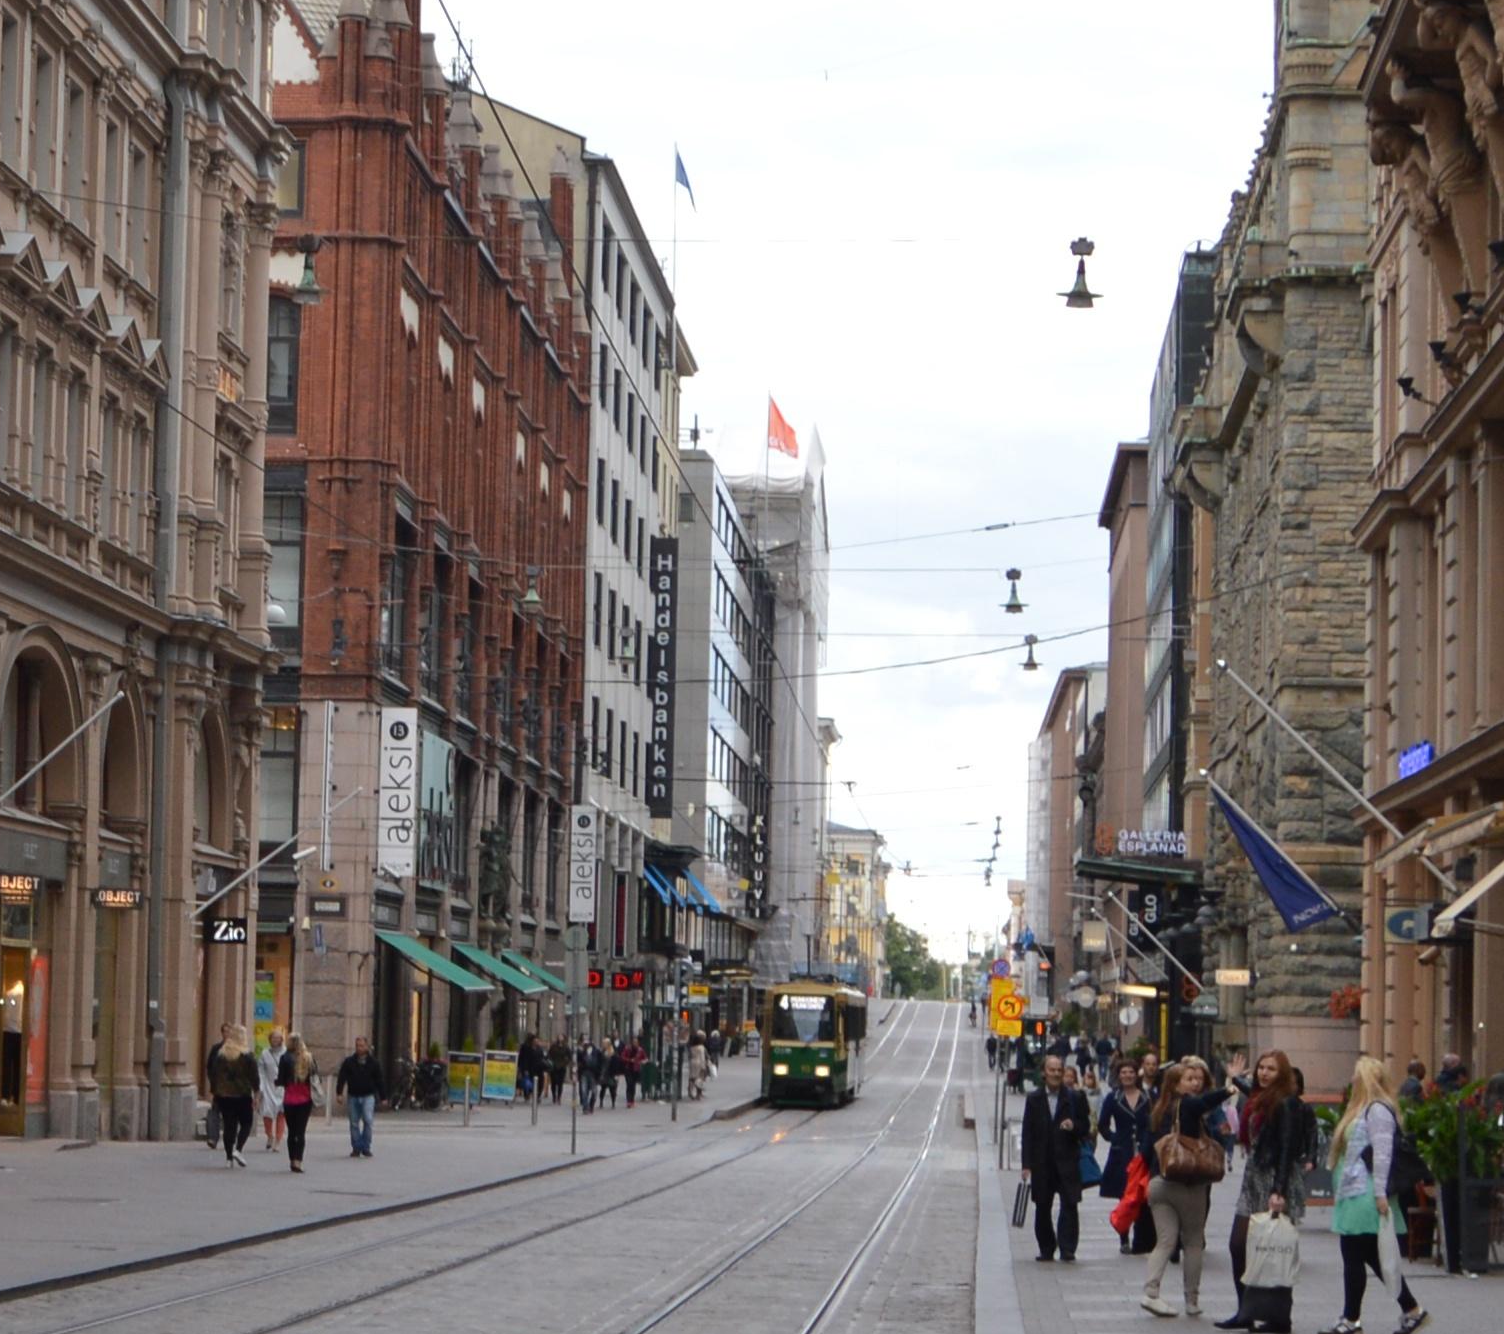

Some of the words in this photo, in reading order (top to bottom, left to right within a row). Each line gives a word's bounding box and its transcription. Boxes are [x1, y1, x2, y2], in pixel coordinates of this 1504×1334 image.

[652, 554, 673, 798] Handelsbanken
[381, 746, 413, 843] aleksi
[1118, 829, 1186, 842] GALLERIA
[1118, 841, 1187, 854] ESPLANAD
[572, 831, 593, 899] aleksi
[754, 815, 764, 918] KLUUVI
[1144, 894, 1157, 923] GLO
[779, 994, 789, 1010] 4
